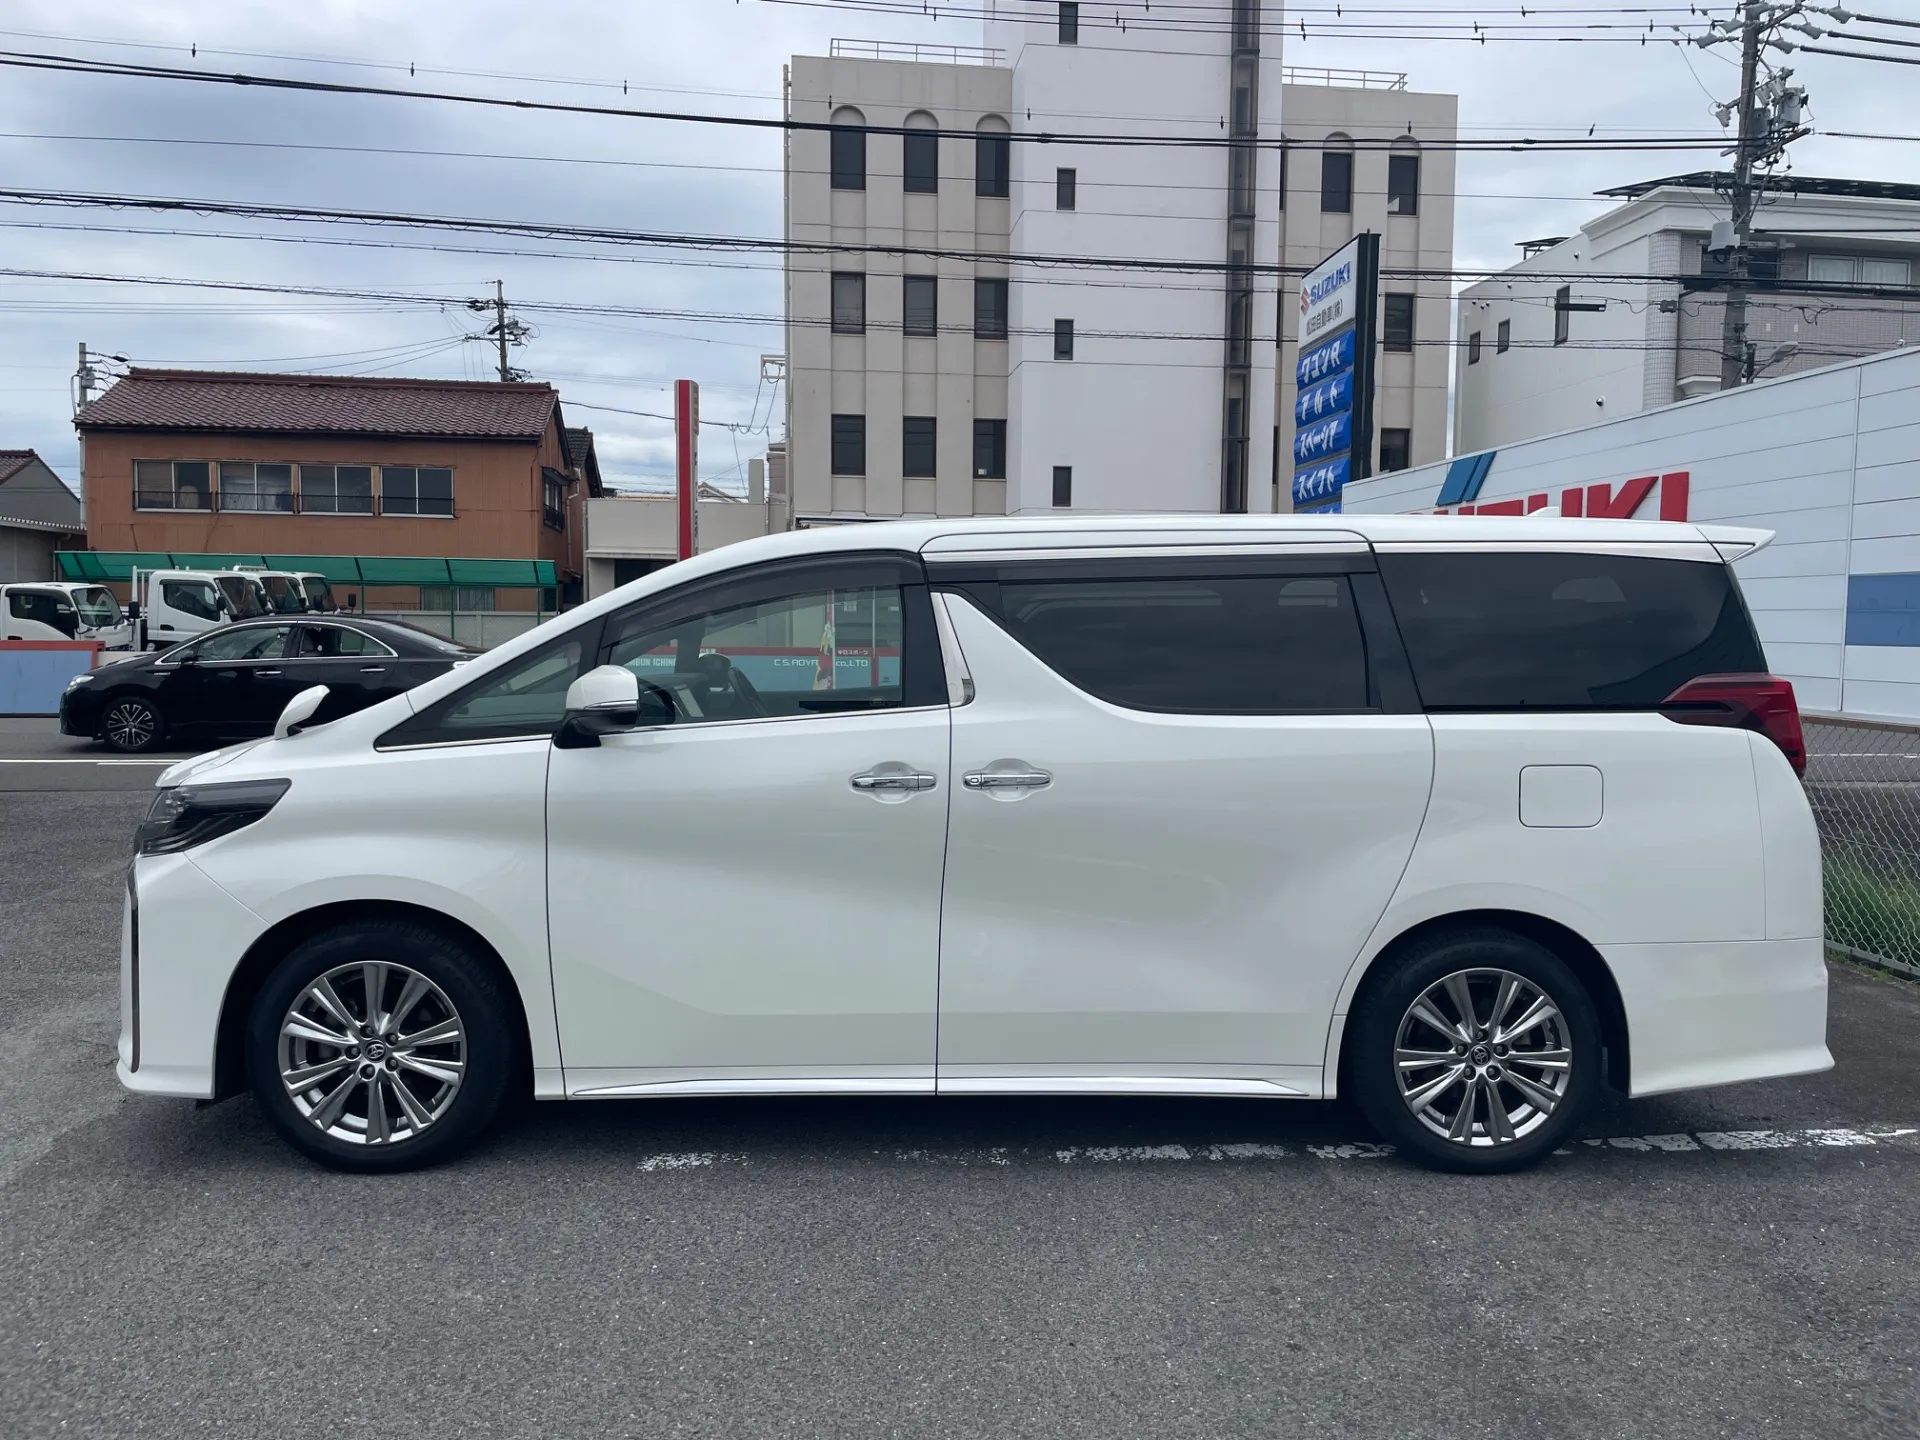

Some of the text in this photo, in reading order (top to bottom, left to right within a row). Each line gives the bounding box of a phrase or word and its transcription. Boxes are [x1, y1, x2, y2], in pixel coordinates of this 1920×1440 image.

[1310, 261, 1350, 305] SUZUKI
[1301, 339, 1340, 383] ワゴンR
[1300, 380, 1338, 421] アルト
[1299, 420, 1338, 458] スペーシア
[1297, 465, 1336, 500] スイフト
